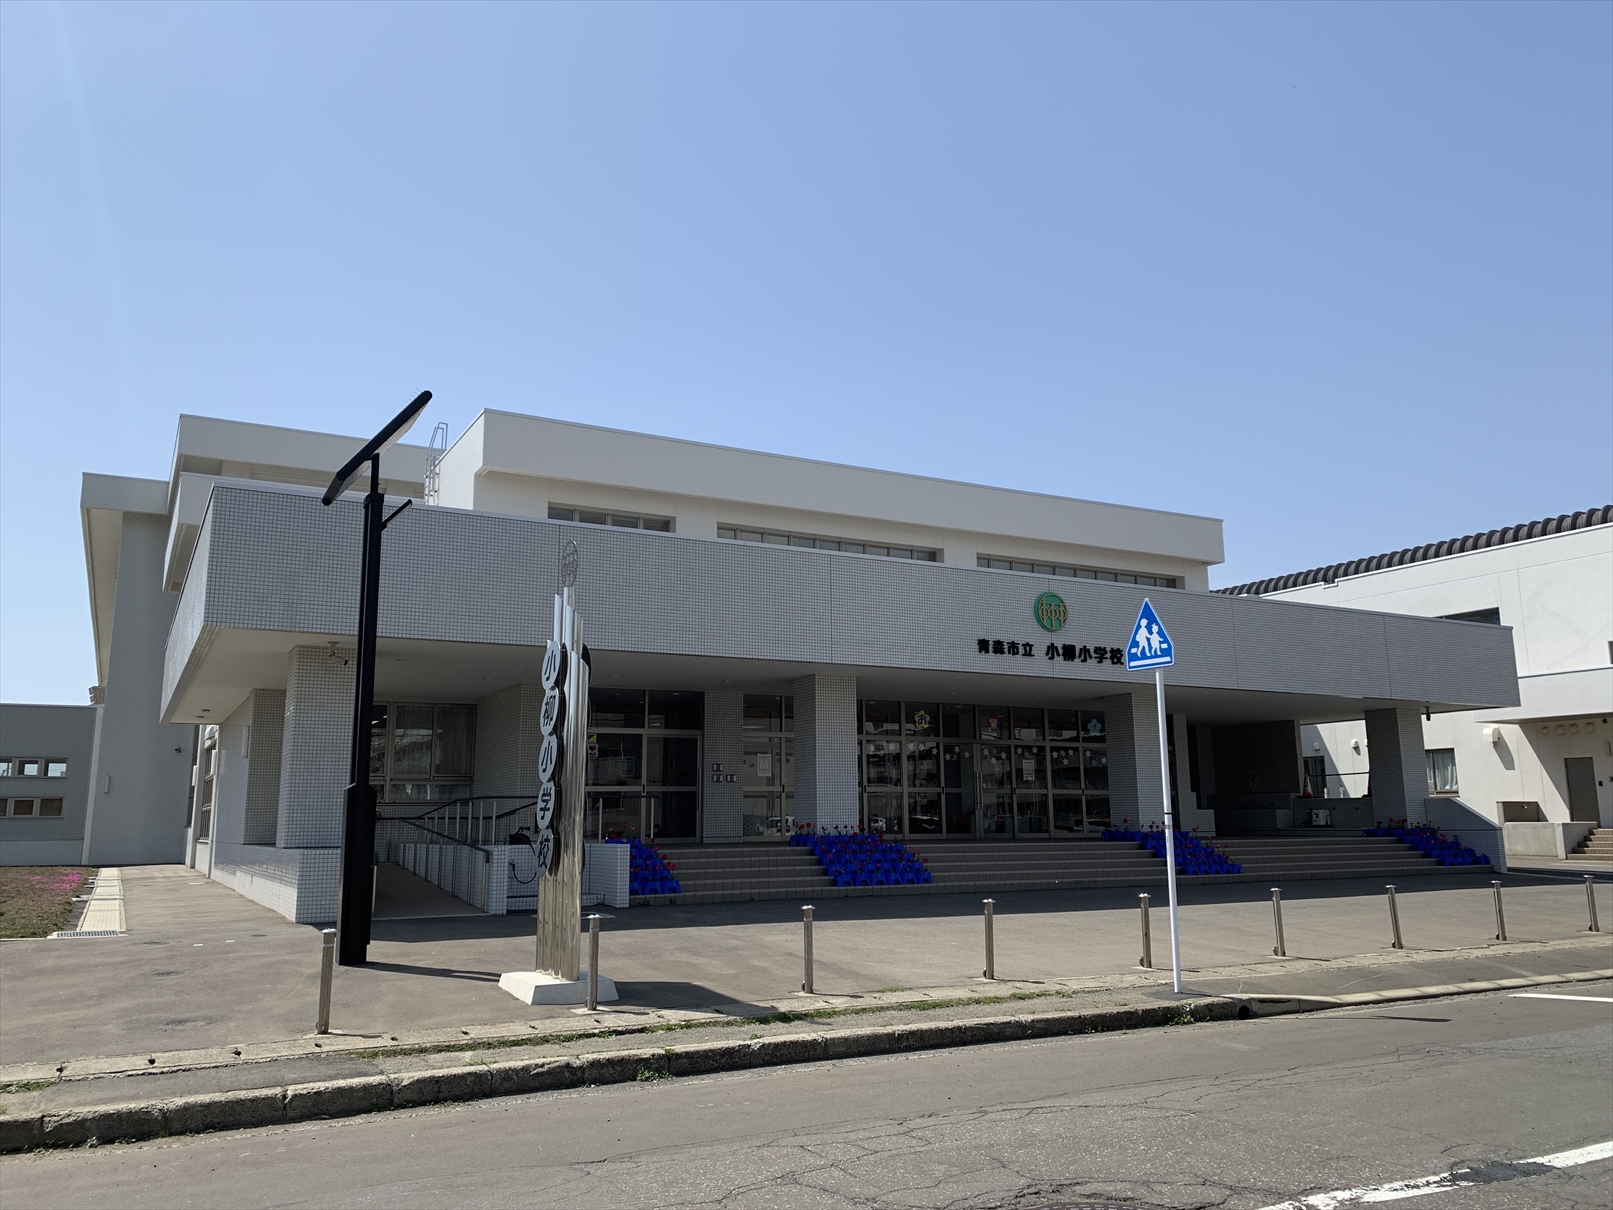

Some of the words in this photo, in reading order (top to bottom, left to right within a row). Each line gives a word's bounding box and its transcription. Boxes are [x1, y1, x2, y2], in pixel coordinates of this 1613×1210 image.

[977, 638, 1035, 657] 青森市立
[1045, 643, 1125, 665] 小柳小学校
[537, 650, 557, 868] 小柳小学校
